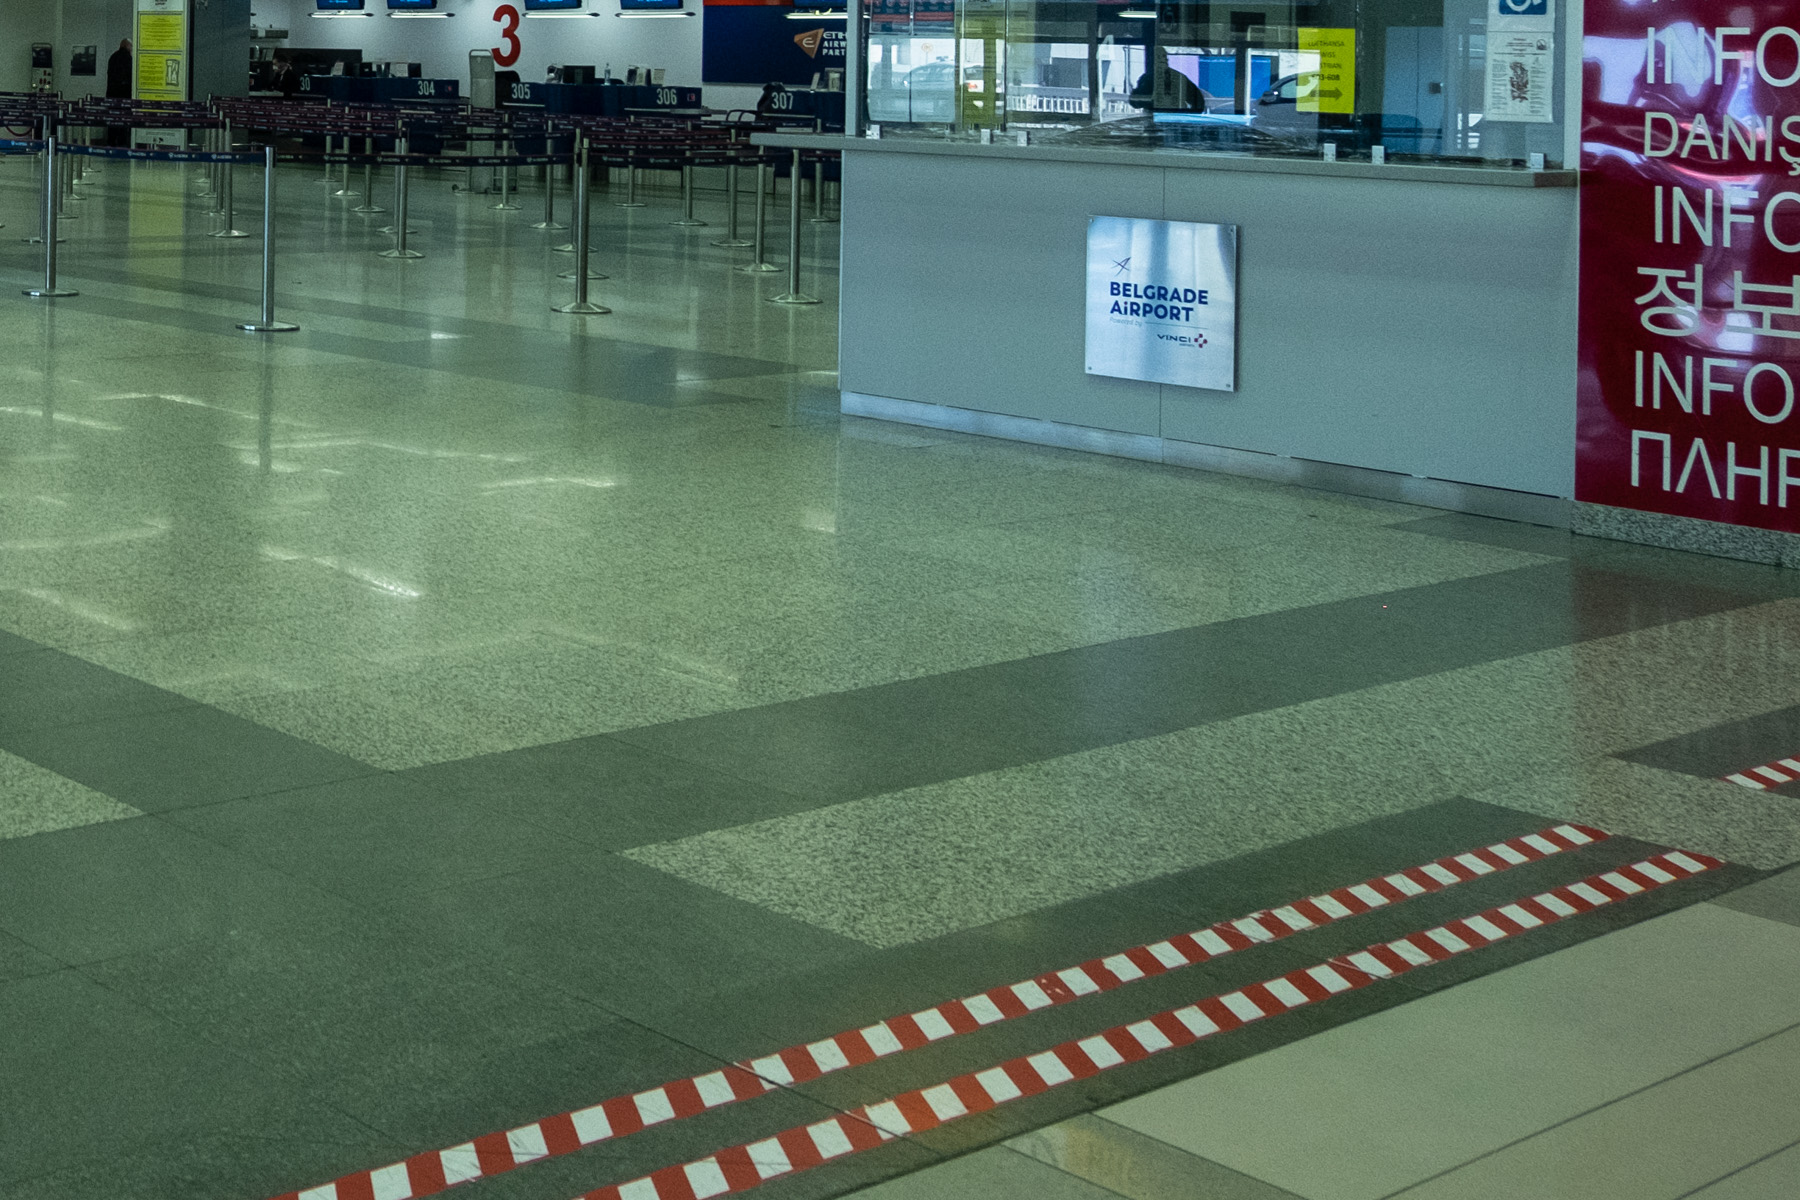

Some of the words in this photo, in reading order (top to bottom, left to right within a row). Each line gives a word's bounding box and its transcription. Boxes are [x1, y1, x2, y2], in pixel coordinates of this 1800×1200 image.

[491, 3, 522, 68] 3
[1646, 26, 1800, 89] INFO
[417, 80, 436, 96] 304
[511, 82, 530, 100] 305
[656, 88, 678, 106] 306
[771, 92, 794, 110] 307
[1654, 186, 1800, 254] INFO
[1109, 281, 1209, 305] BELGRADE
[1634, 263, 1800, 339] 정보
[1634, 349, 1794, 425] INFO
